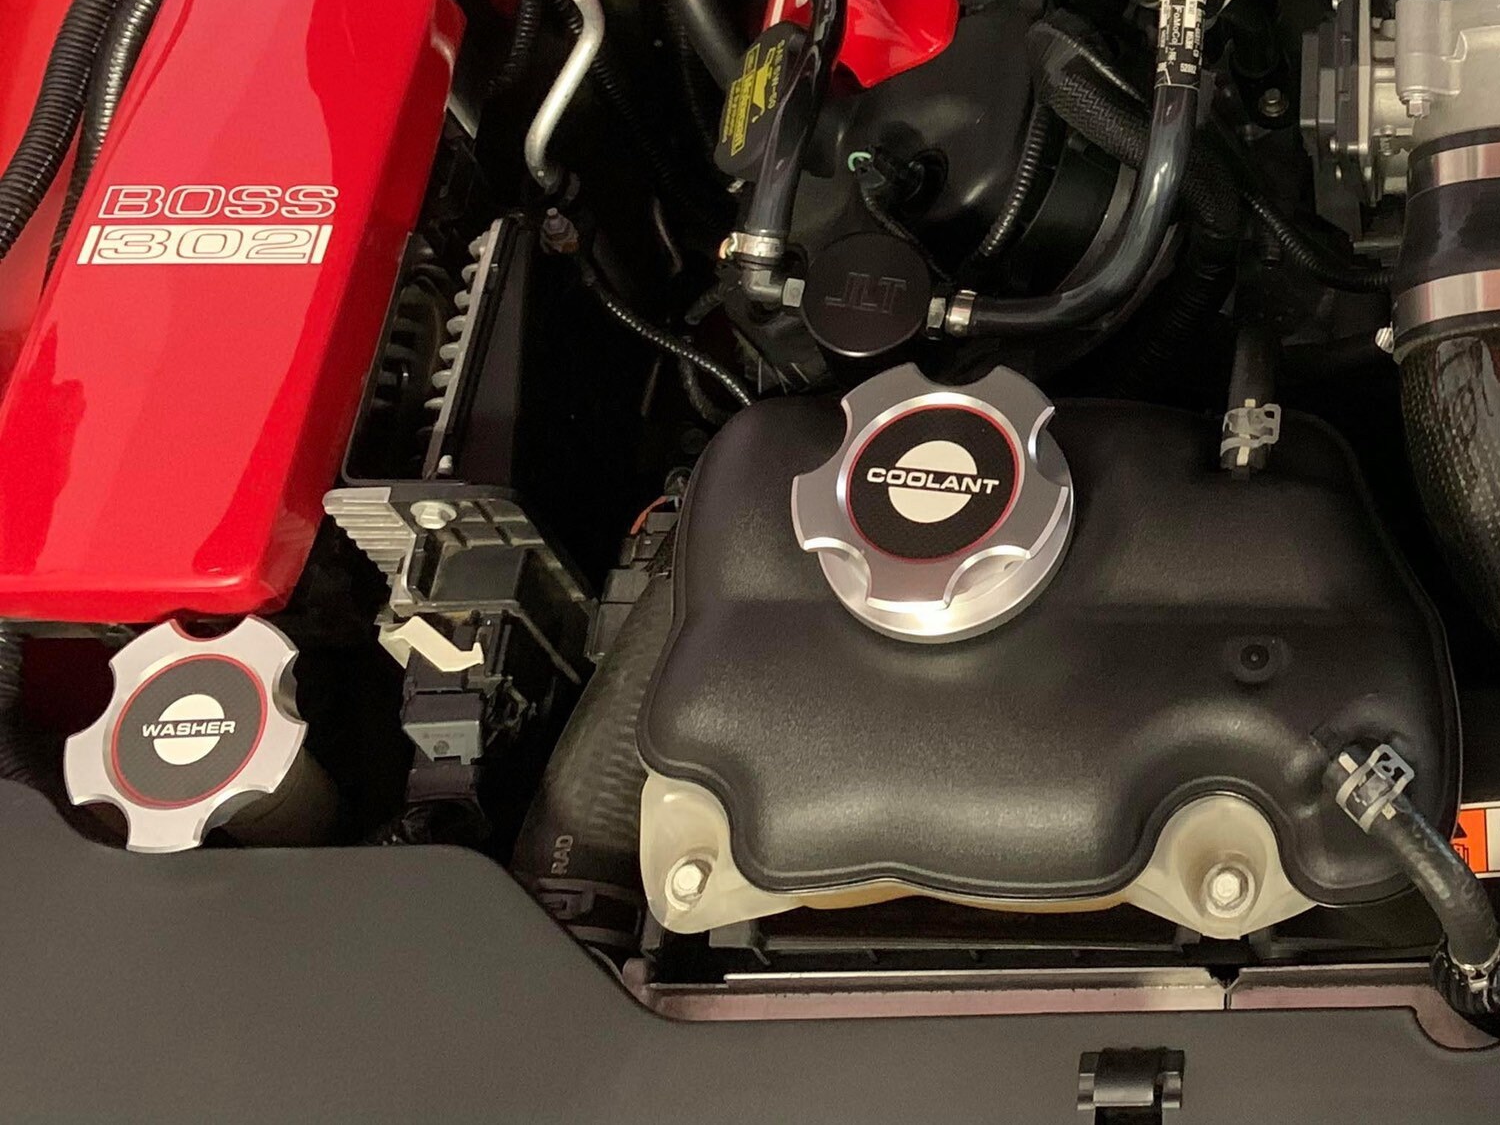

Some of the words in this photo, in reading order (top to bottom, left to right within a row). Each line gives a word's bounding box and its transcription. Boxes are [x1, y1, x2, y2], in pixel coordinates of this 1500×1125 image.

[1170, 6, 1183, 45] FoMoCo
[98, 185, 339, 219] BOSS
[96, 227, 313, 260] 302
[826, 272, 907, 314] JLT
[866, 468, 1000, 495] COOLANT
[142, 721, 236, 737] WASHER
[551, 834, 574, 876] RAD
